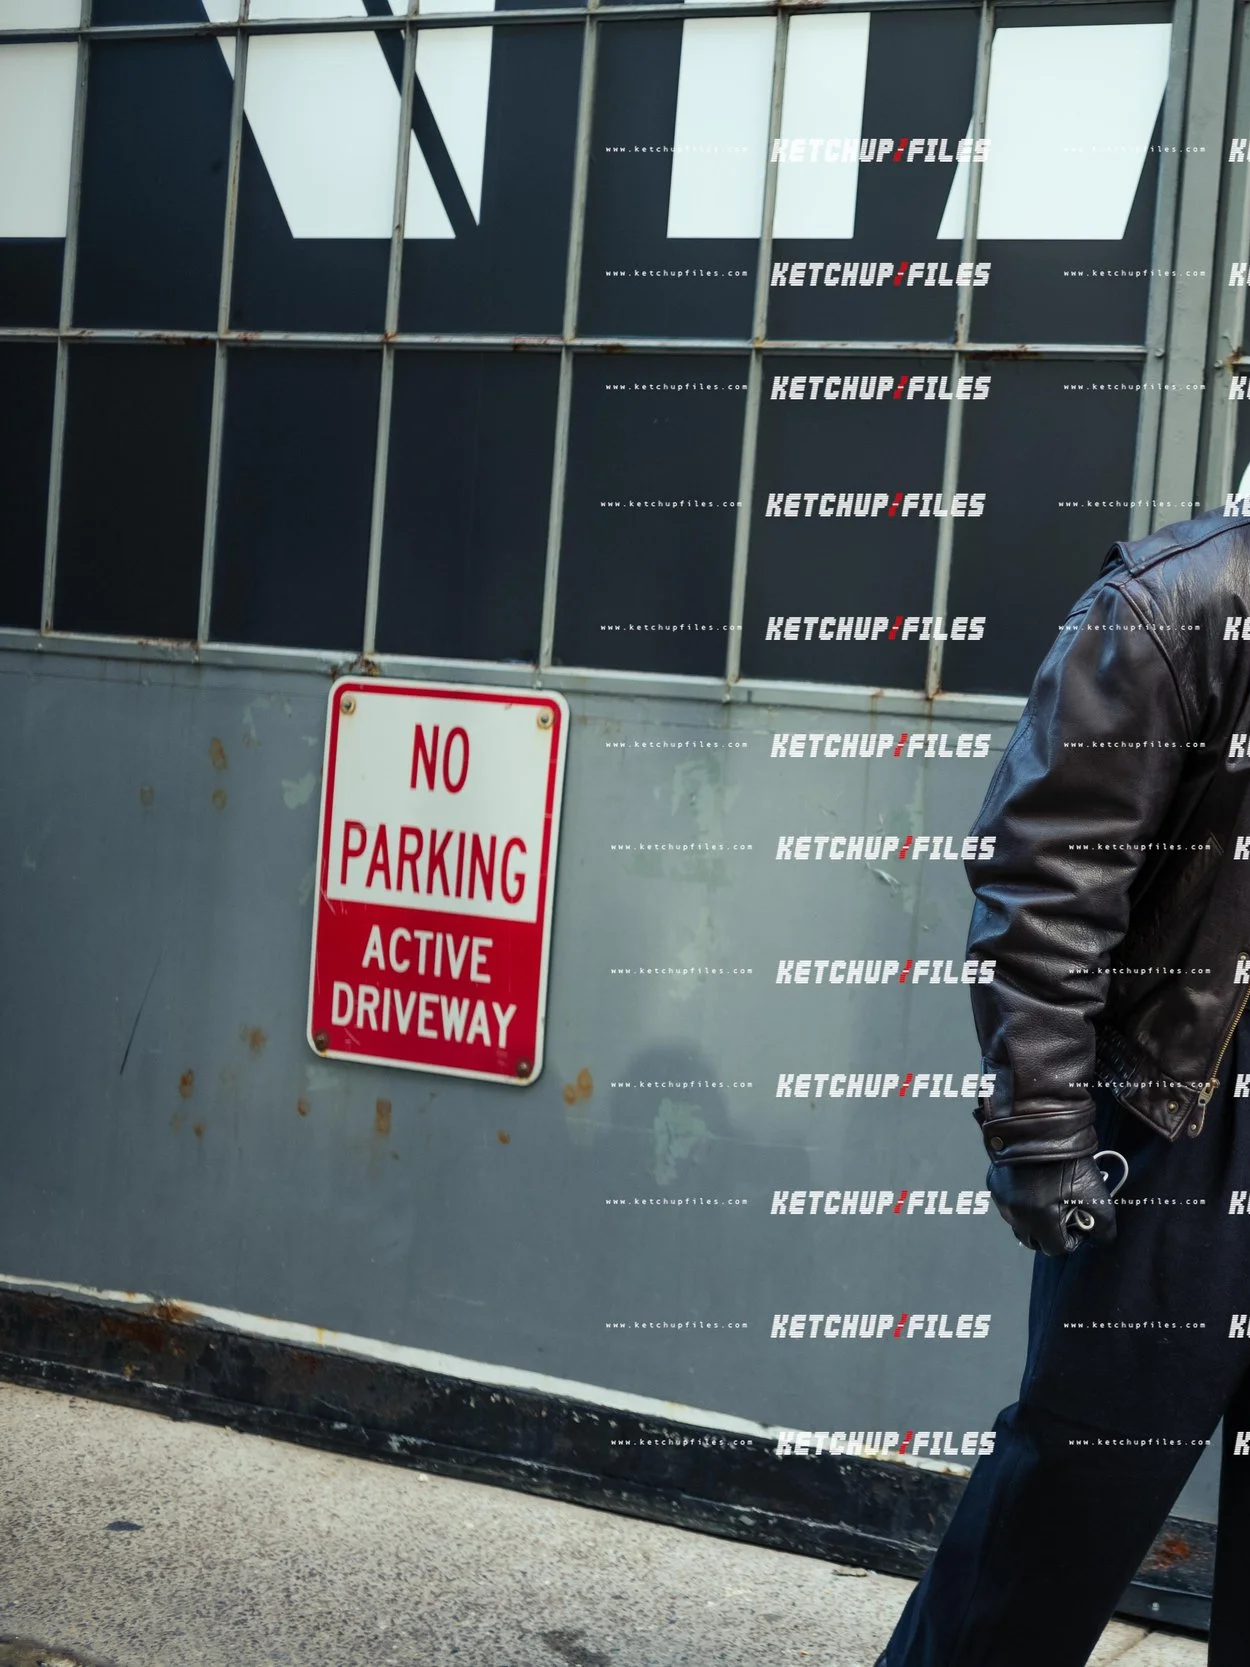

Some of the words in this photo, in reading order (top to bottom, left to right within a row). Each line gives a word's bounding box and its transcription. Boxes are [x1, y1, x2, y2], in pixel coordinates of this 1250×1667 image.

[410, 724, 470, 794] NO
[340, 820, 527, 904] PARKING
[362, 925, 493, 983] ACTIVE
[331, 982, 517, 1049] DRIVEWAY
